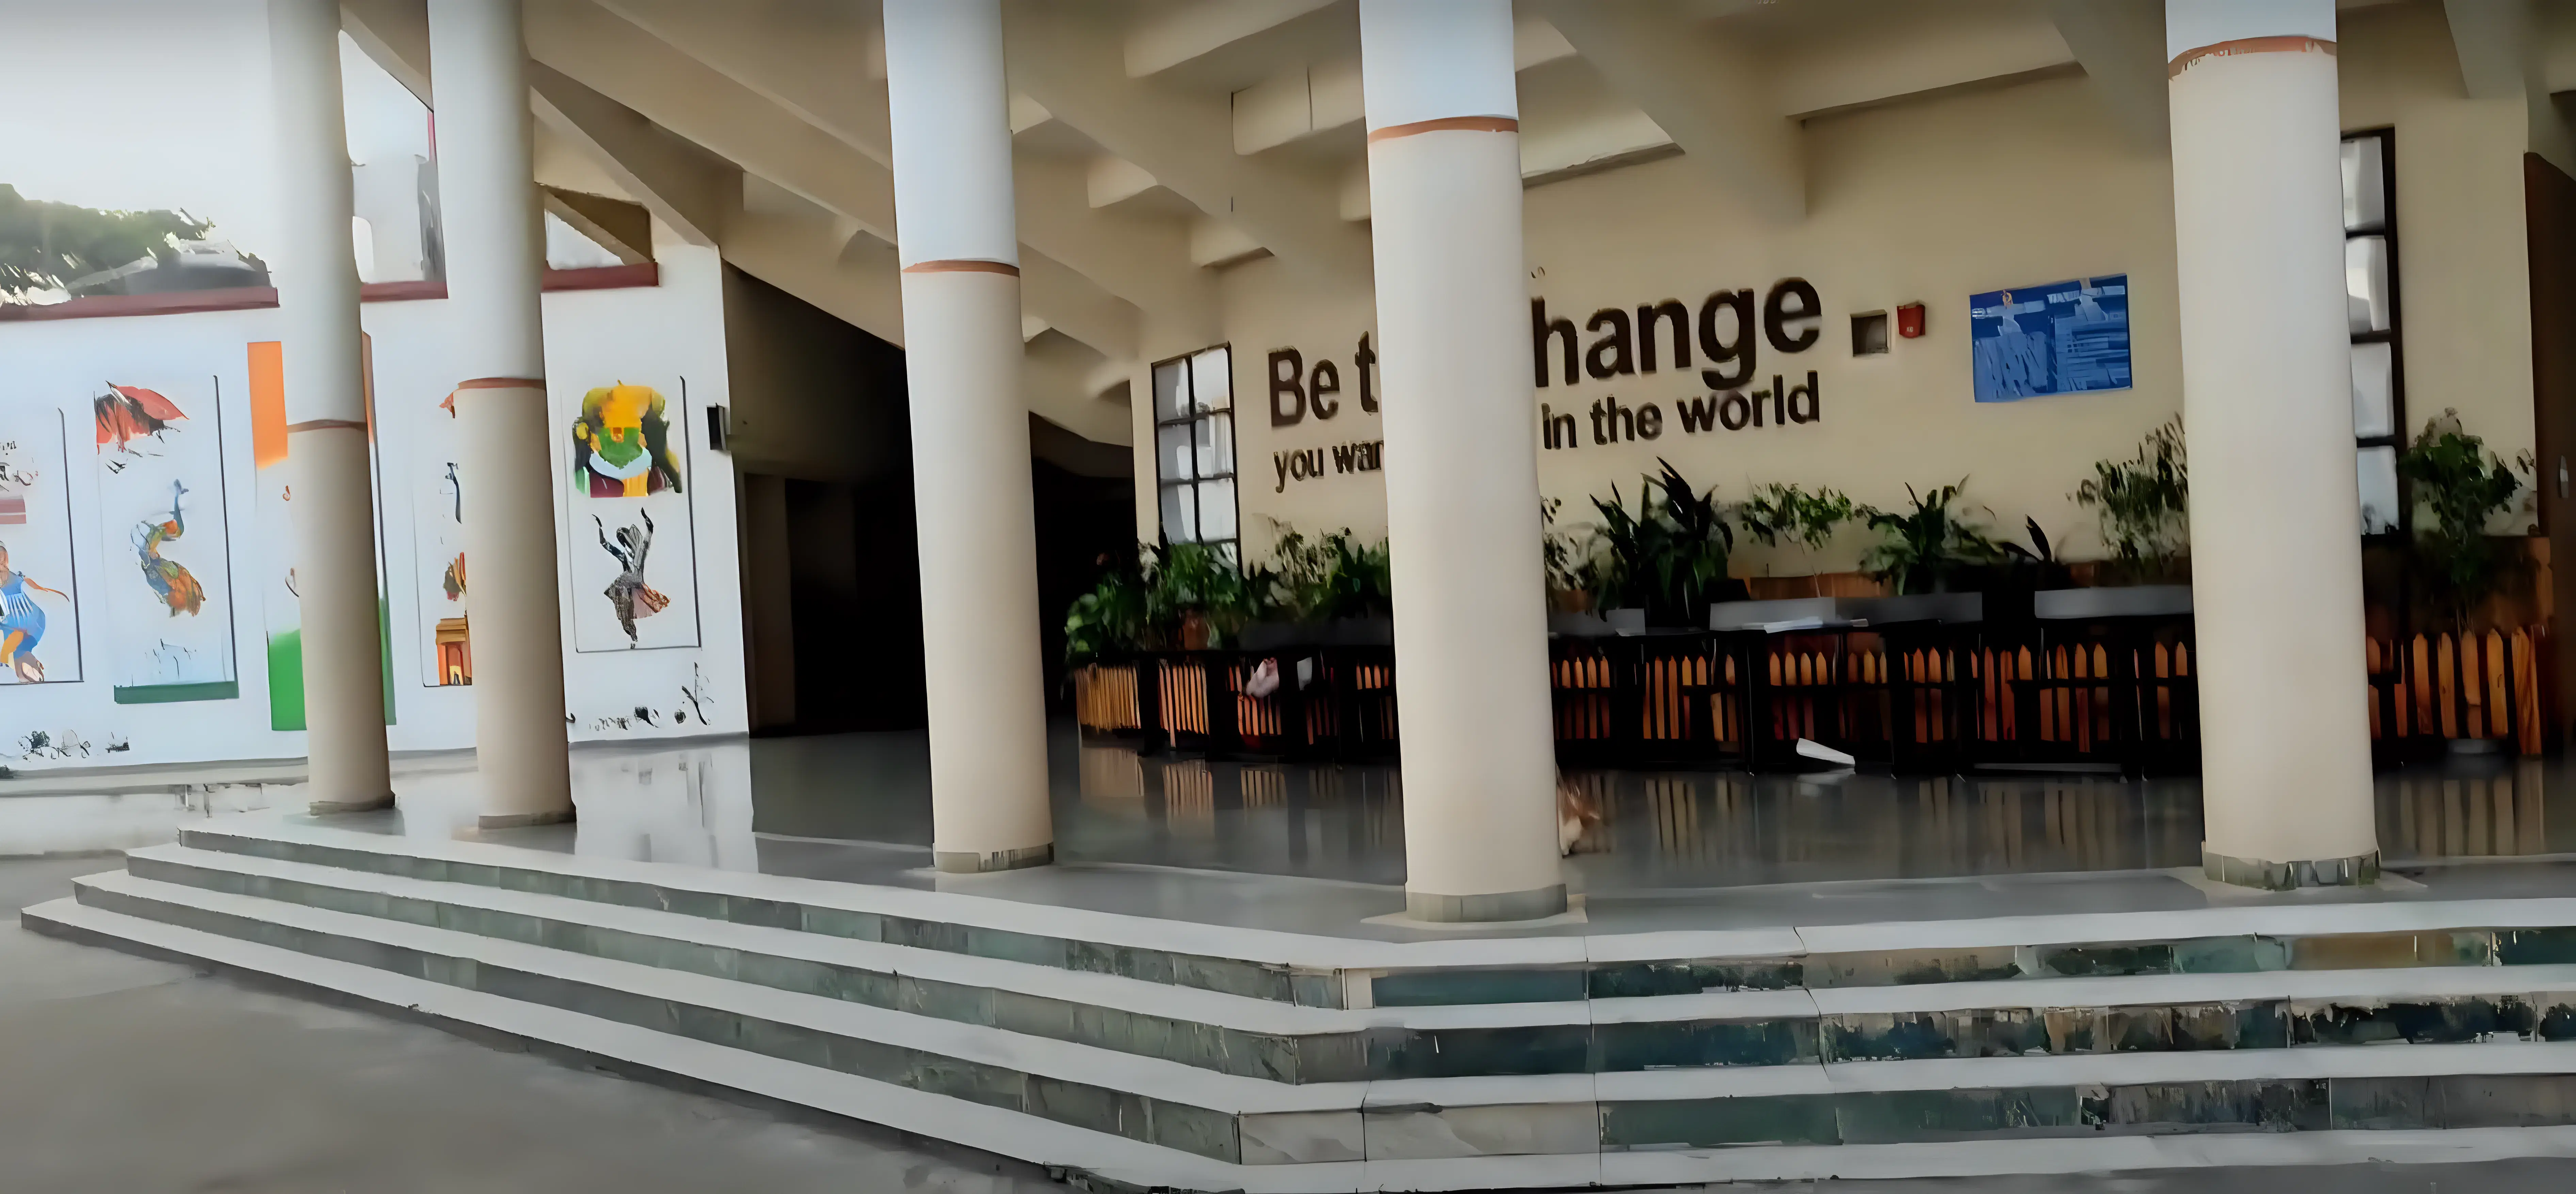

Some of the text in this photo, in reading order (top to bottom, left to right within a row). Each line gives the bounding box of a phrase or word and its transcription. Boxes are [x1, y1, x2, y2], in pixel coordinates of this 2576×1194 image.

[1268, 345, 1340, 427] Be
[1531, 276, 1822, 390] hange
[1273, 370, 1820, 494] you wan in the world
